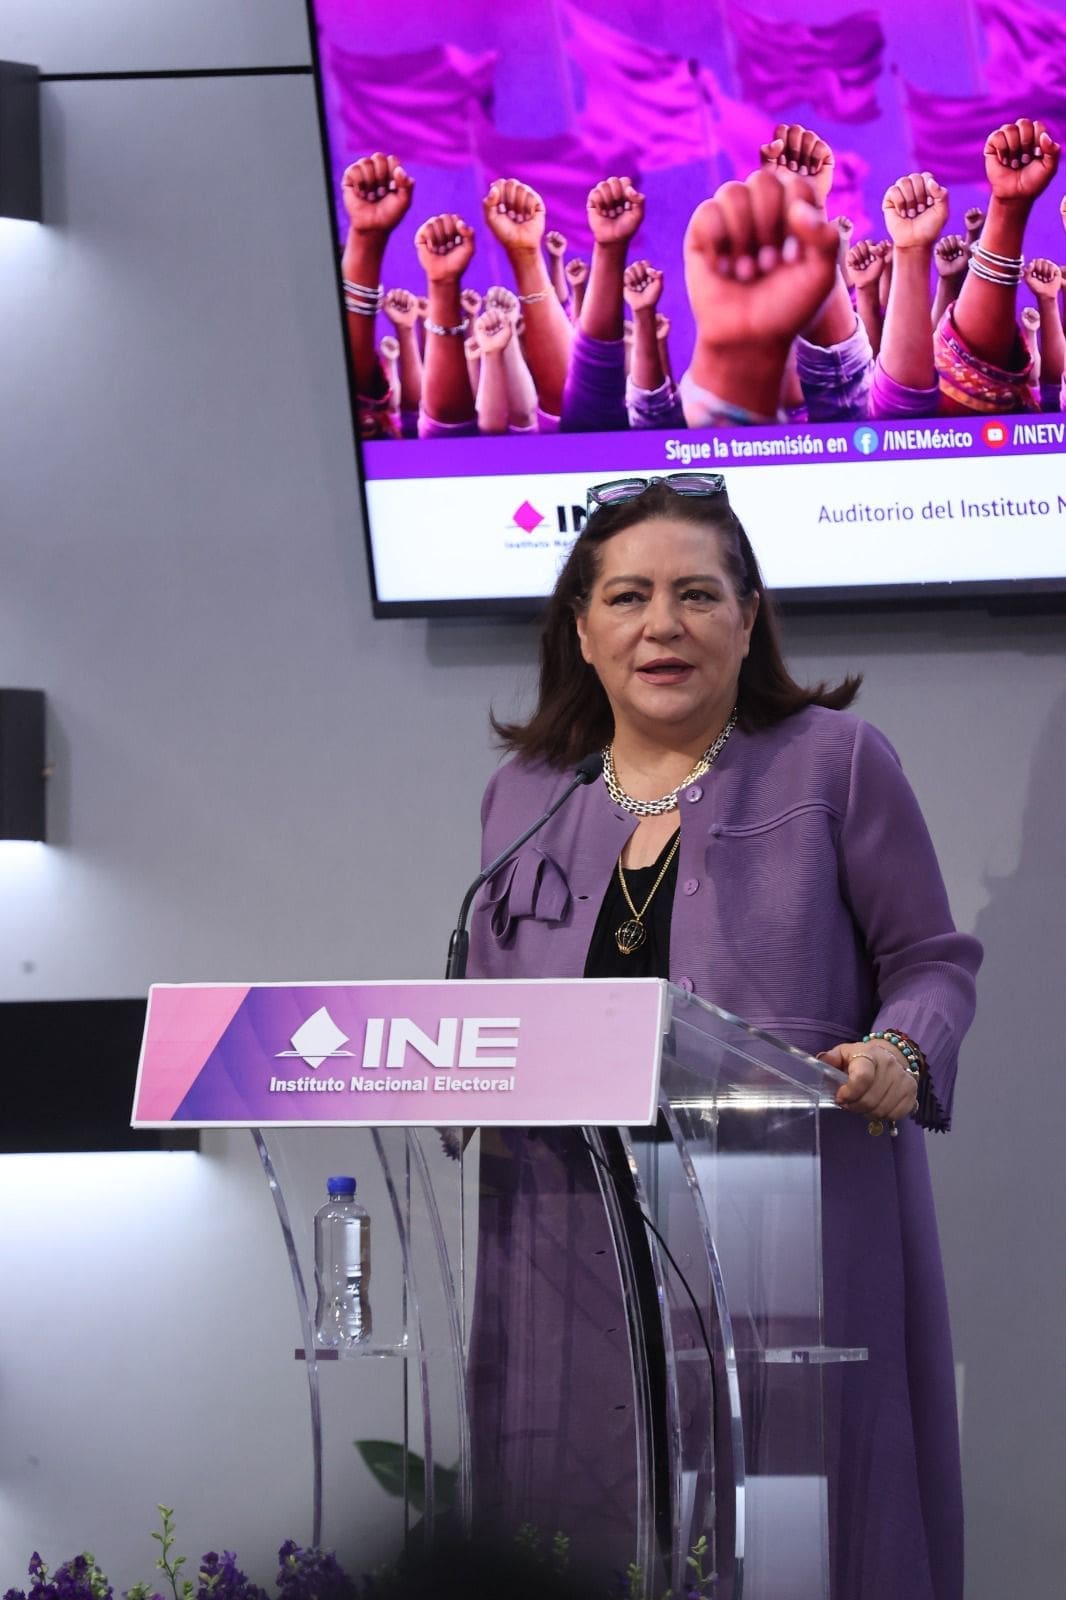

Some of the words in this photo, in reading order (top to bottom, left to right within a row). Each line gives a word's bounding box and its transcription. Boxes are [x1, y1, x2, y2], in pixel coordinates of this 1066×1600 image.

[665, 439, 711, 465] Sigue
[713, 437, 729, 458] la
[730, 434, 824, 457] transmisión
[826, 437, 848, 453] en
[883, 429, 973, 451] /INEMéxico
[1012, 423, 1065, 446] /INETV
[818, 502, 914, 524] Auditorio
[922, 499, 954, 519] del
[961, 497, 1050, 518] Instituto
[362, 1017, 521, 1068] INE
[269, 1076, 345, 1092] Instituto
[350, 1076, 428, 1092] Nacional
[433, 1076, 515, 1091] Electoral
